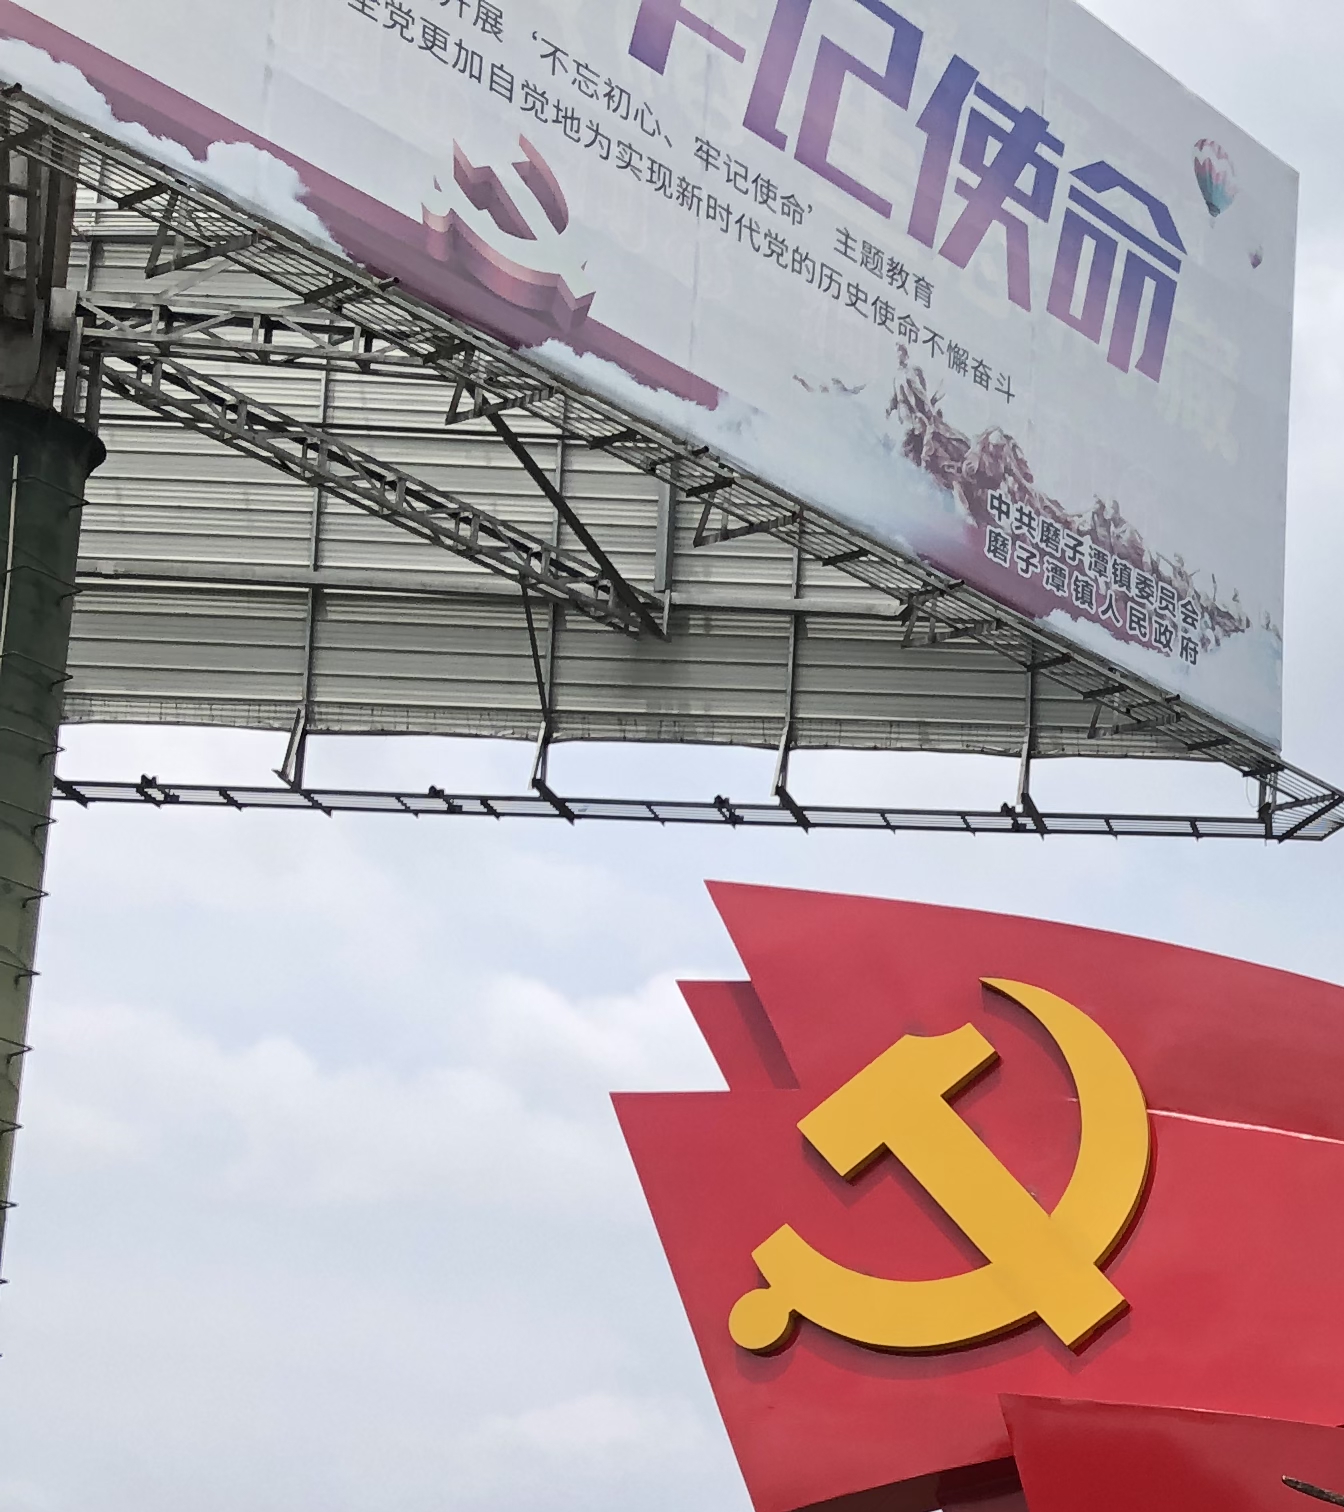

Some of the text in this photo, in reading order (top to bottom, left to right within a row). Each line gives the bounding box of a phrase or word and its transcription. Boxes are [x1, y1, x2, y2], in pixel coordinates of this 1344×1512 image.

[987, 527, 1199, 665] 磨子潭镇人民政府
[989, 492, 1199, 630] 中共磨子潭镇委员会
